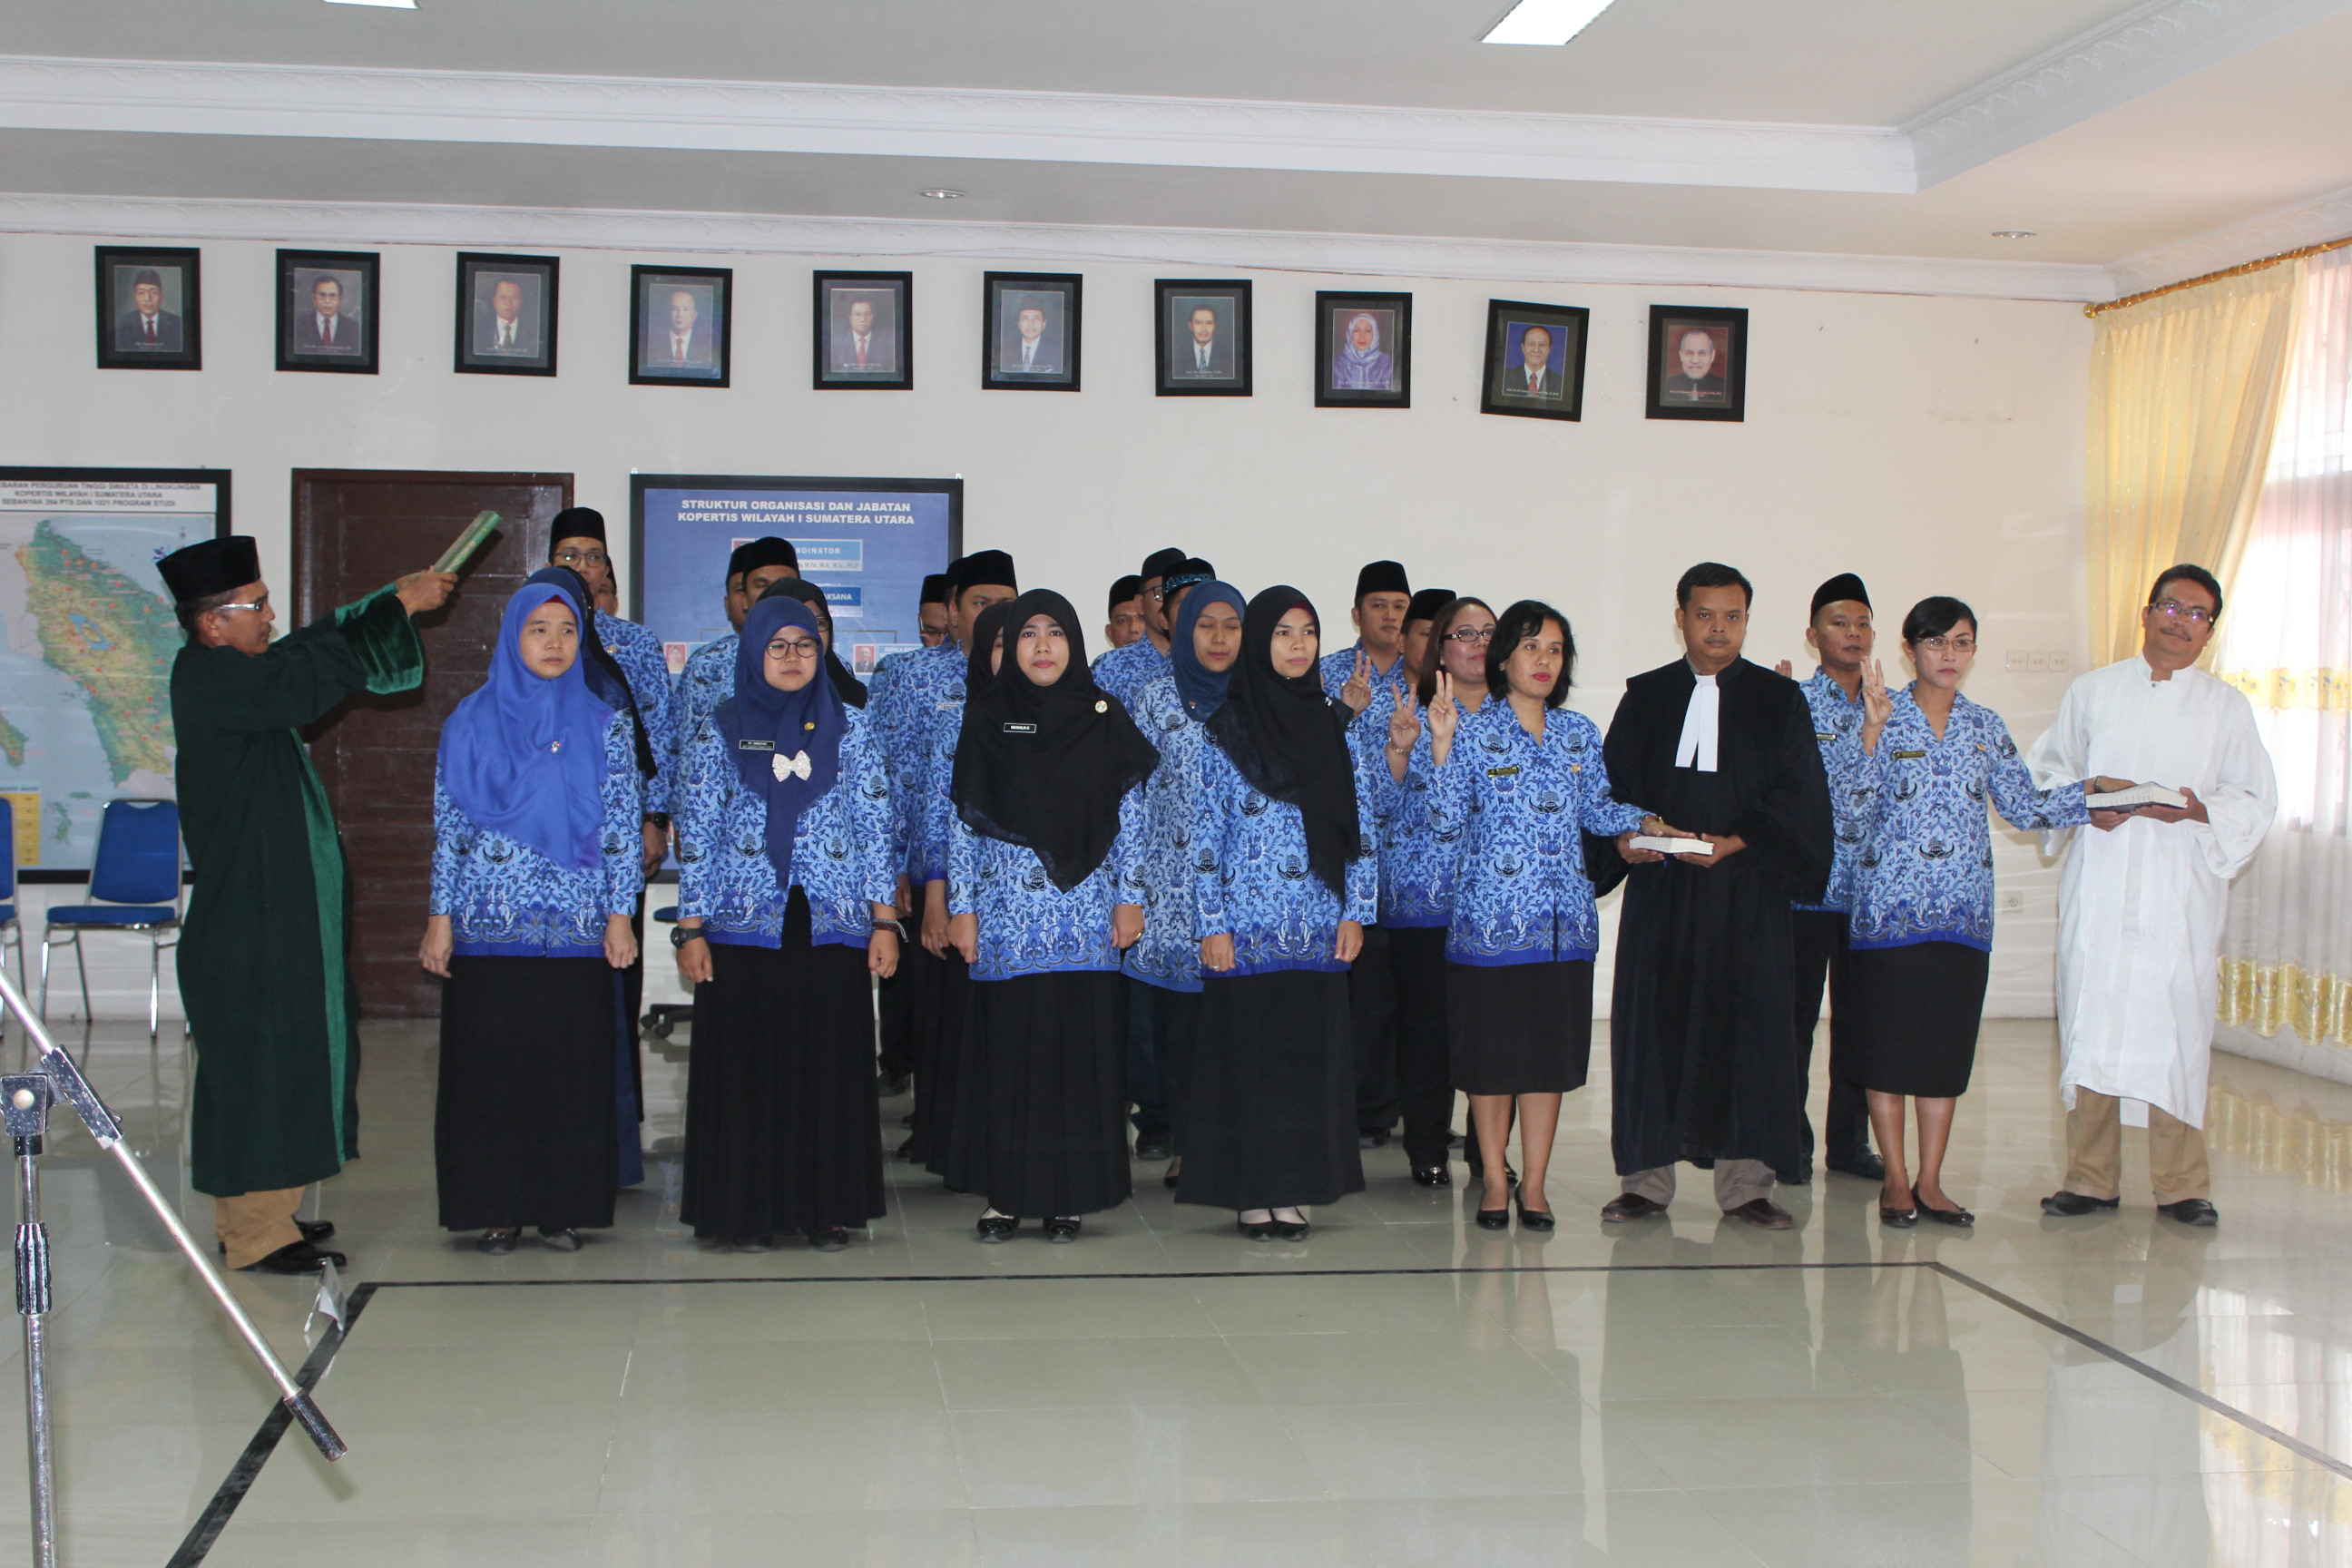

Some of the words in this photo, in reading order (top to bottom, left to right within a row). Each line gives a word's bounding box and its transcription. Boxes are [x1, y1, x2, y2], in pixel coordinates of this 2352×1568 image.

[681, 500, 748, 510] STRUKTUR
[750, 501, 825, 511] ORGANISASI
[828, 502, 853, 511] DAN
[856, 503, 910, 512] JABATAN
[678, 513, 738, 522] KOPERTIS
[741, 514, 794, 523] WILAYAH
[806, 514, 871, 524] SUMATERA
[874, 515, 915, 524] UTARA
